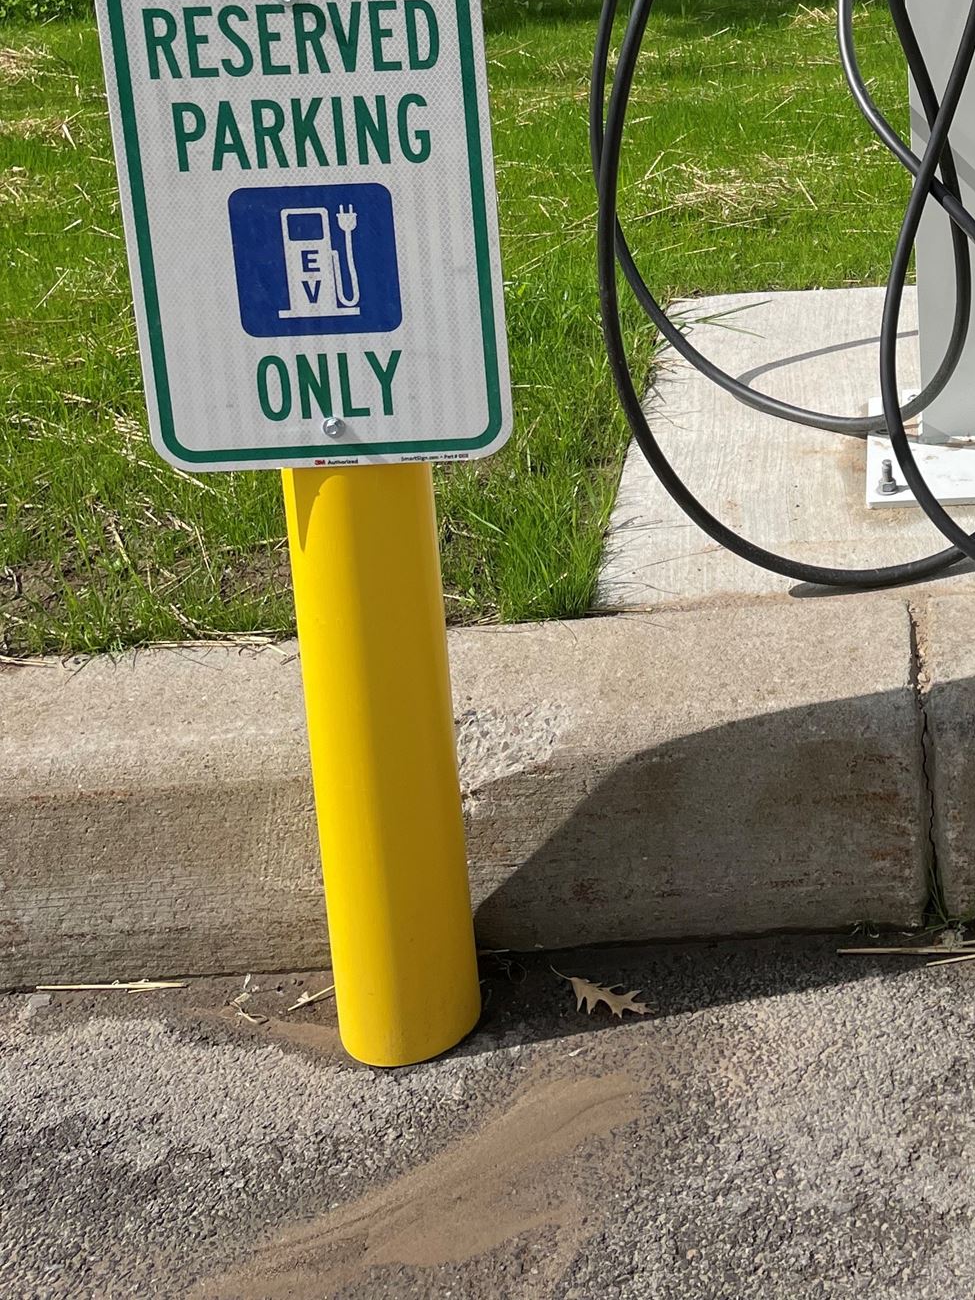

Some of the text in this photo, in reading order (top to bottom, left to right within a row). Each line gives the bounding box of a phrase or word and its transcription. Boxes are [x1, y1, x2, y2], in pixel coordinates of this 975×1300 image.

[143, 0, 440, 80] RESERVED
[172, 93, 432, 172] PARKING
[256, 349, 402, 422] ONLY
